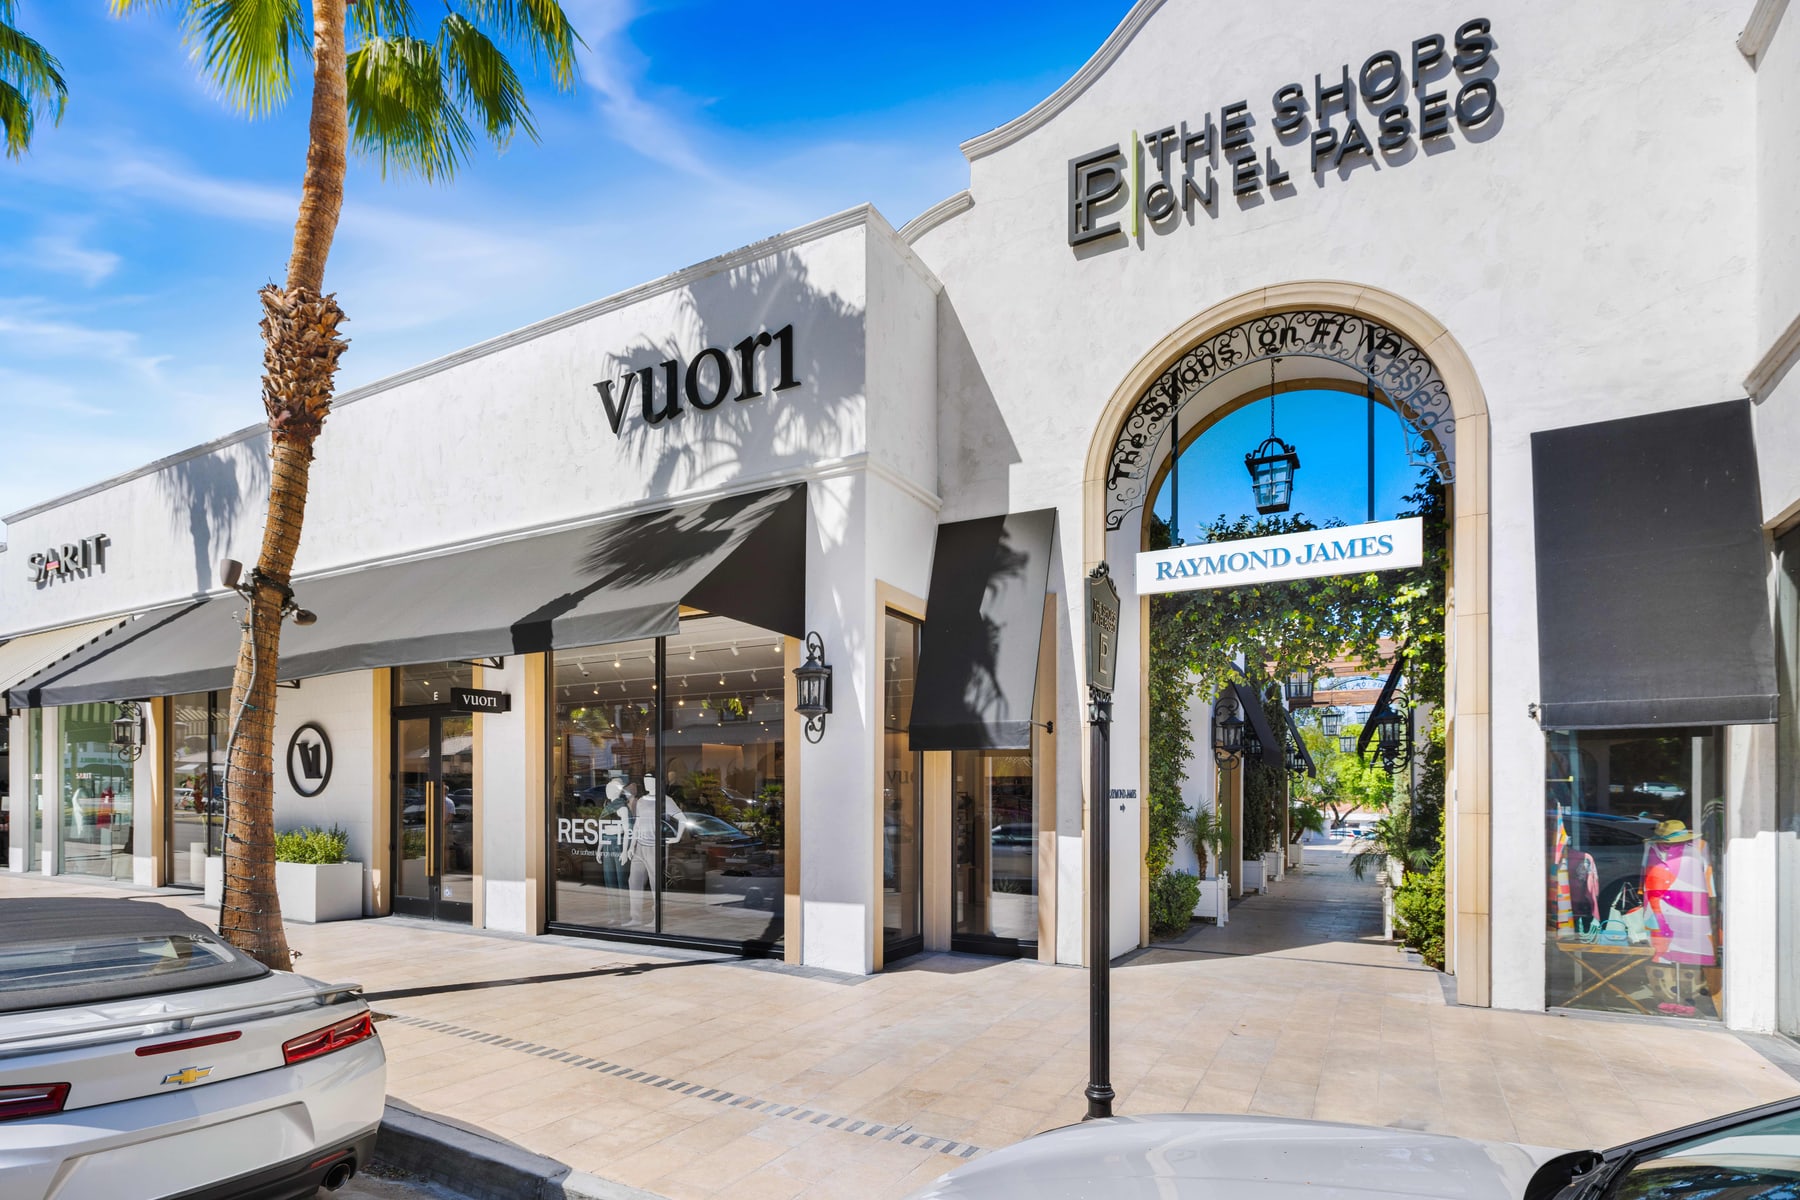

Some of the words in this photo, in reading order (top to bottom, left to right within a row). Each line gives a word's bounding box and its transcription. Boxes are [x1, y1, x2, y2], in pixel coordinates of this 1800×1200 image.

[1144, 100, 1248, 171] THE
[1272, 17, 1493, 133] SHOPS
[1144, 166, 1213, 221] ON
[1234, 146, 1290, 196] EL
[1311, 77, 1498, 172] PASEO
[1258, 326, 1297, 347] on
[592, 324, 802, 434] vuori
[27, 533, 107, 583] SARIT
[1156, 547, 1291, 581] RAYMOND
[1296, 534, 1394, 566] JAMES
[433, 691, 439, 701] E
[462, 694, 498, 707] vuori
[558, 818, 625, 845] RESET
